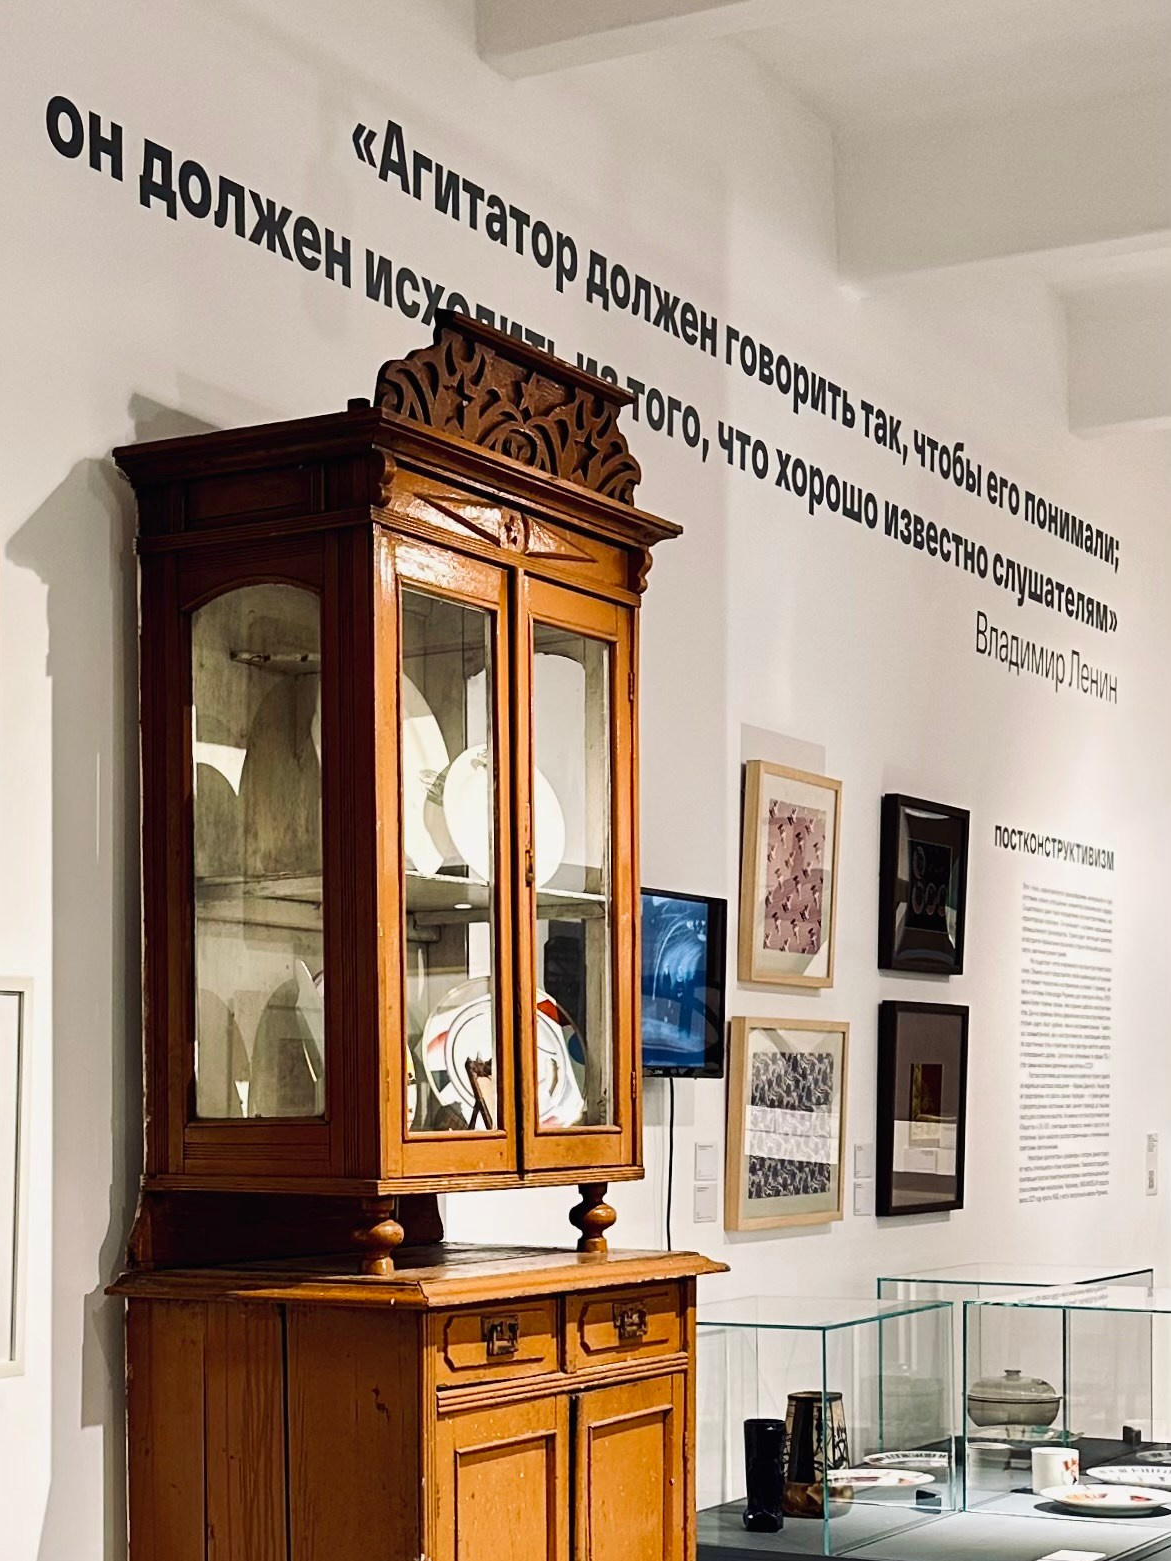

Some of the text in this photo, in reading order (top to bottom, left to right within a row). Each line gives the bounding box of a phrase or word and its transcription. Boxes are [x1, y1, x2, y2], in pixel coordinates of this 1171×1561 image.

[45, 95, 124, 182] он
[138, 137, 352, 289] должен
[626, 375, 710, 463] того,
[717, 420, 769, 480] что
[774, 448, 878, 530] хорошо
[884, 500, 989, 579] известно
[992, 552, 1118, 633] слушателям»
[352, 119, 1120, 573] «Агитатор должен говорить так, чтобы его понимали;
[975, 610, 1118, 705] Владимир Ленин
